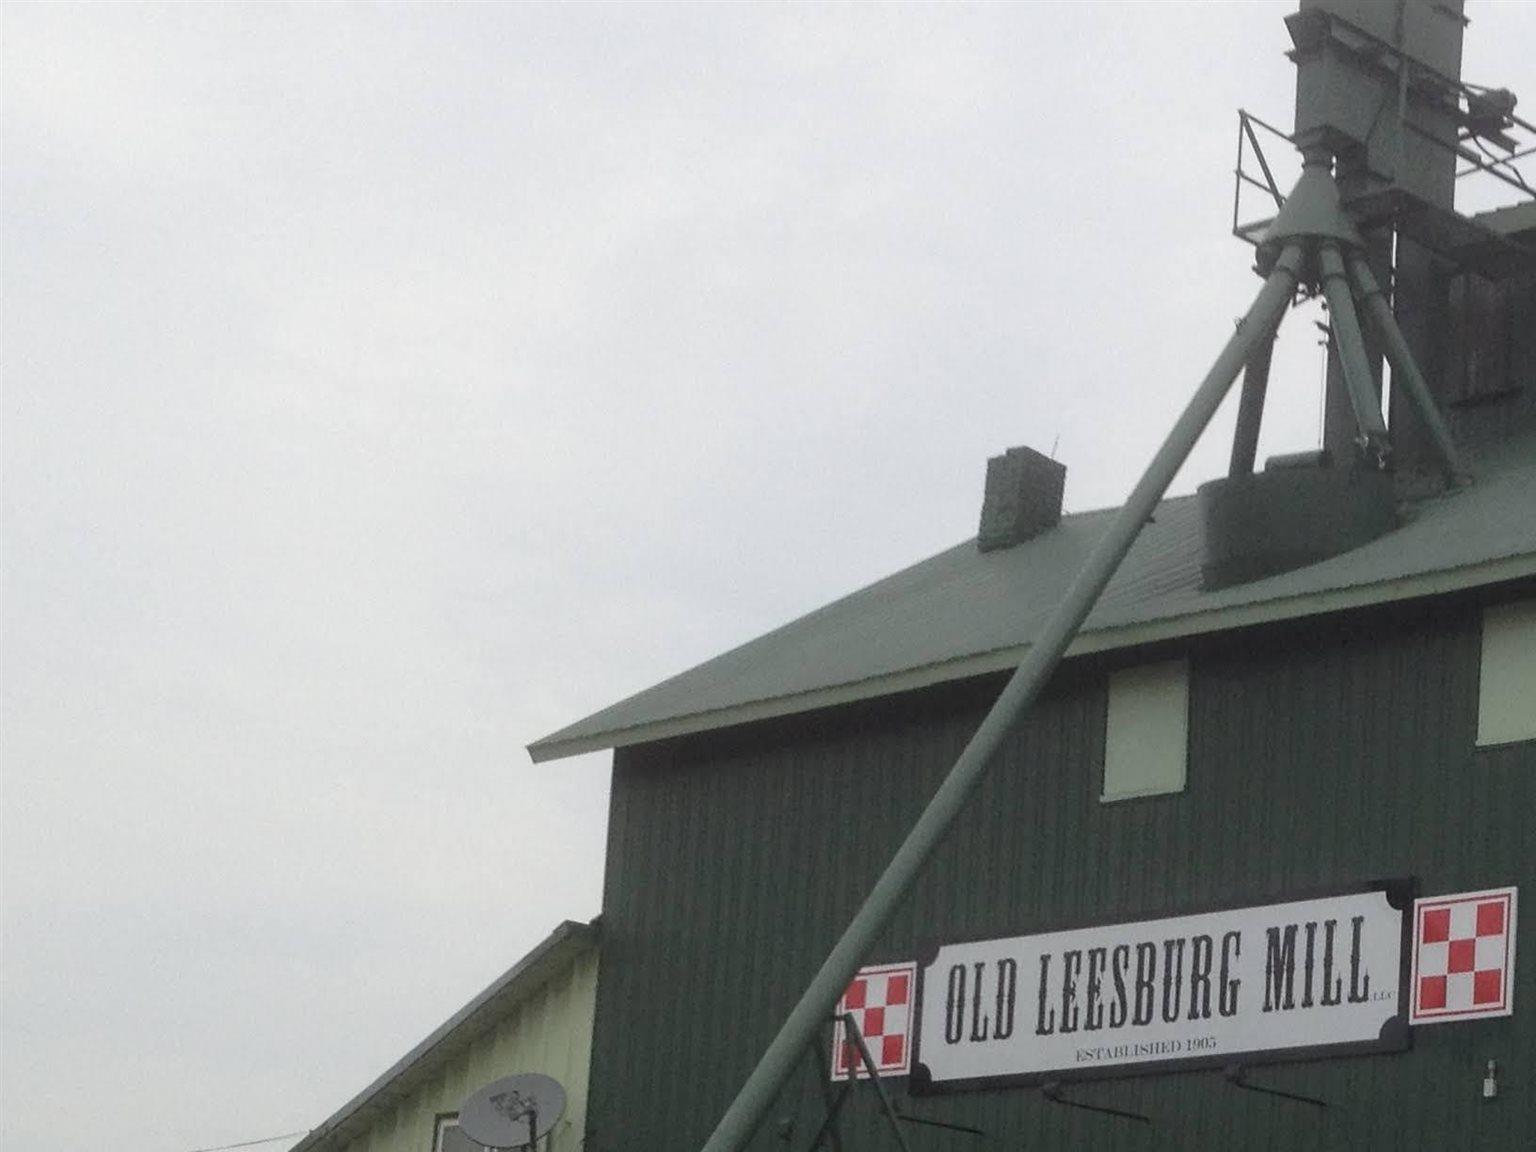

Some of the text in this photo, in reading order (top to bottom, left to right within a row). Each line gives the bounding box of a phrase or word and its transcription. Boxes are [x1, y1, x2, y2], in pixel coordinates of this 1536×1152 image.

[945, 957, 1017, 1044] OLD
[1035, 931, 1241, 1035] LEESBURG
[1262, 915, 1369, 1012] MILL
[1076, 1038, 1181, 1062] ESTABLISHED
